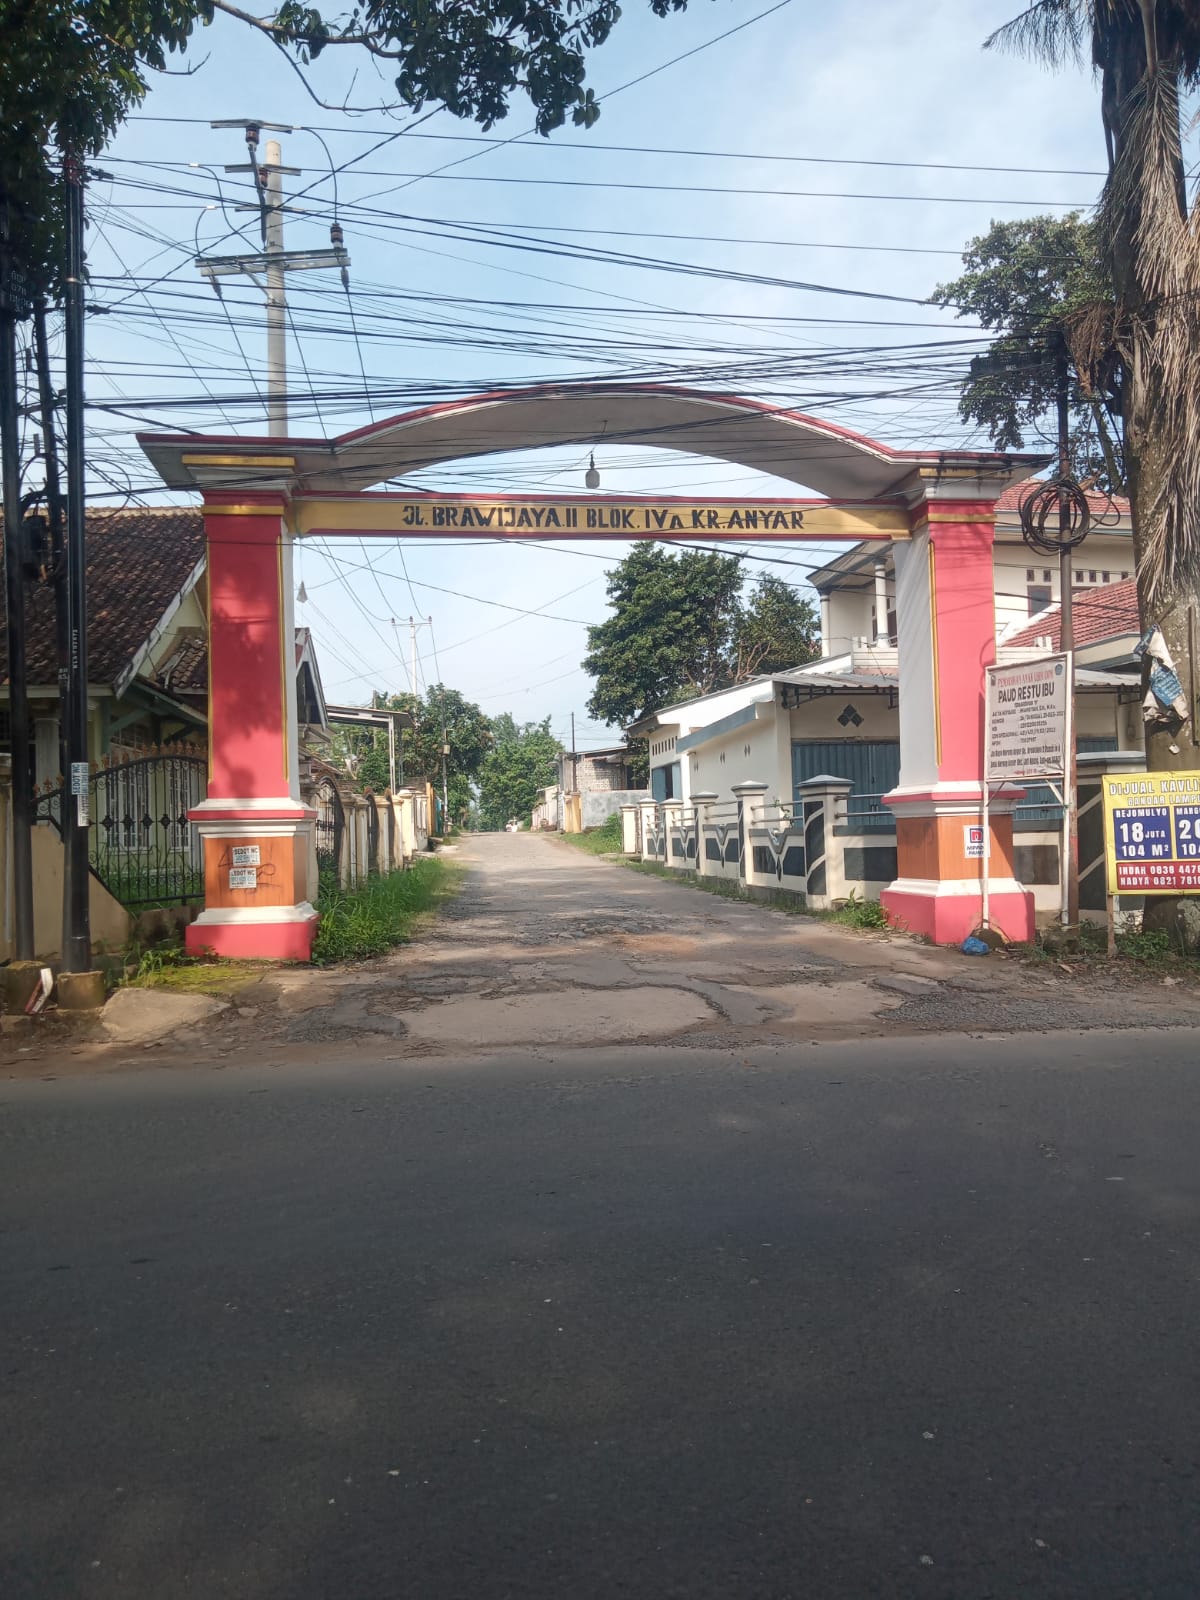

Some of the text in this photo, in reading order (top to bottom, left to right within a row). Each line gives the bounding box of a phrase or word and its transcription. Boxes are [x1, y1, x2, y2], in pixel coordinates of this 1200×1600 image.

[403, 505, 428, 526] JL.
[998, 681, 1055, 703] PAUD RESTU IBU
[1109, 781, 1155, 795] DIJUAL
[1116, 807, 1167, 818] REJOMULYO
[1176, 806, 1200, 815] MARG
[1120, 822, 1166, 843] 18 JUTA
[1121, 845, 1145, 857] 104
[1119, 866, 1147, 875] INDAH
